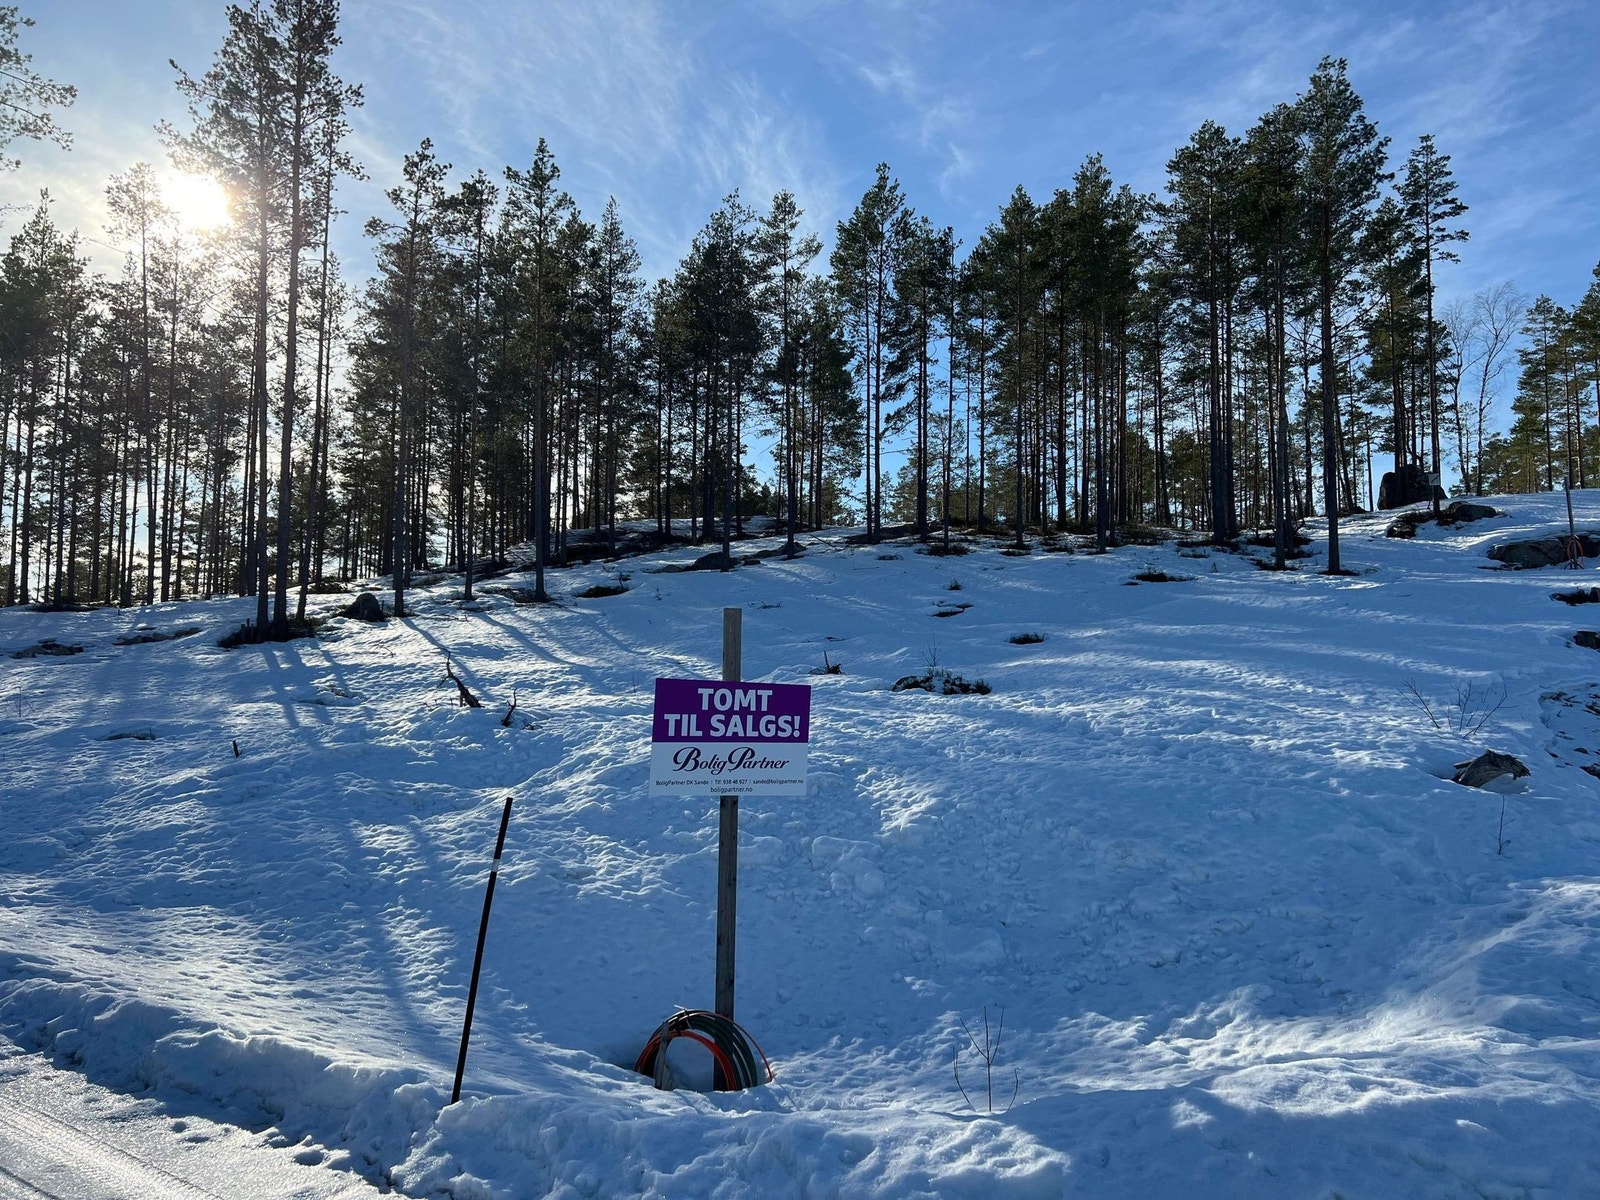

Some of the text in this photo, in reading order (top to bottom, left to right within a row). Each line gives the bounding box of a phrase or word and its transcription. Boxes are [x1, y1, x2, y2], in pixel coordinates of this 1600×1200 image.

[698, 688, 773, 711] TOMT
[664, 713, 801, 738] TIL SALGS!
